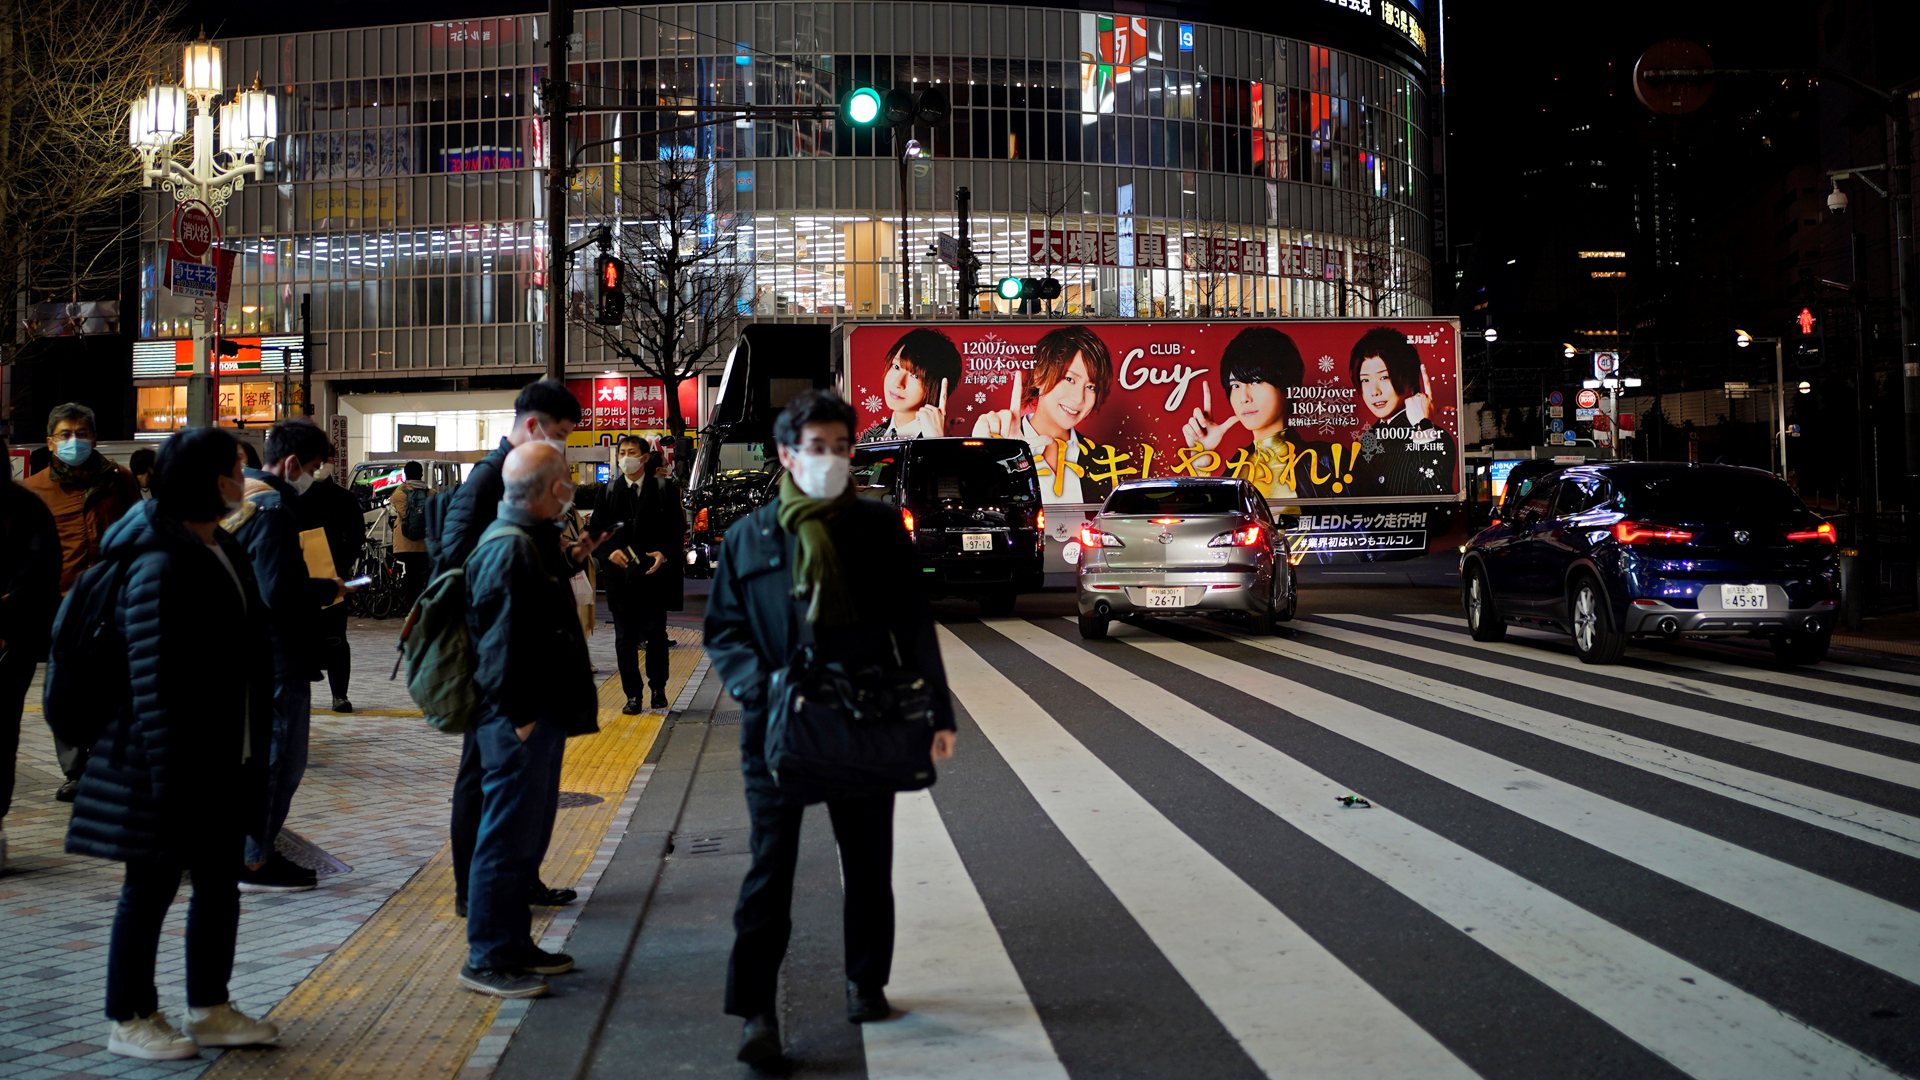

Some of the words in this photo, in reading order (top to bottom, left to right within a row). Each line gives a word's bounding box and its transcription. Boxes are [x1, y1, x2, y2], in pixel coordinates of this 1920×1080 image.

[183, 221, 209, 243] 消火栓
[962, 341, 1037, 355] 1200万over
[1150, 343, 1181, 355] CLUB
[969, 358, 1037, 372] 100本over
[1119, 348, 1209, 412] Guy
[245, 391, 271, 407] 客席
[598, 385, 662, 402] 大塚家具
[1286, 385, 1356, 399] 1200万over
[1292, 401, 1357, 415] 180本over
[1375, 426, 1444, 440] 1000万over
[969, 540, 991, 550] 97-12
[1300, 535, 1413, 548] #業界初はいつもエルコレ
[1154, 595, 1182, 606] 26-71
[1732, 595, 1764, 607] 45-87
